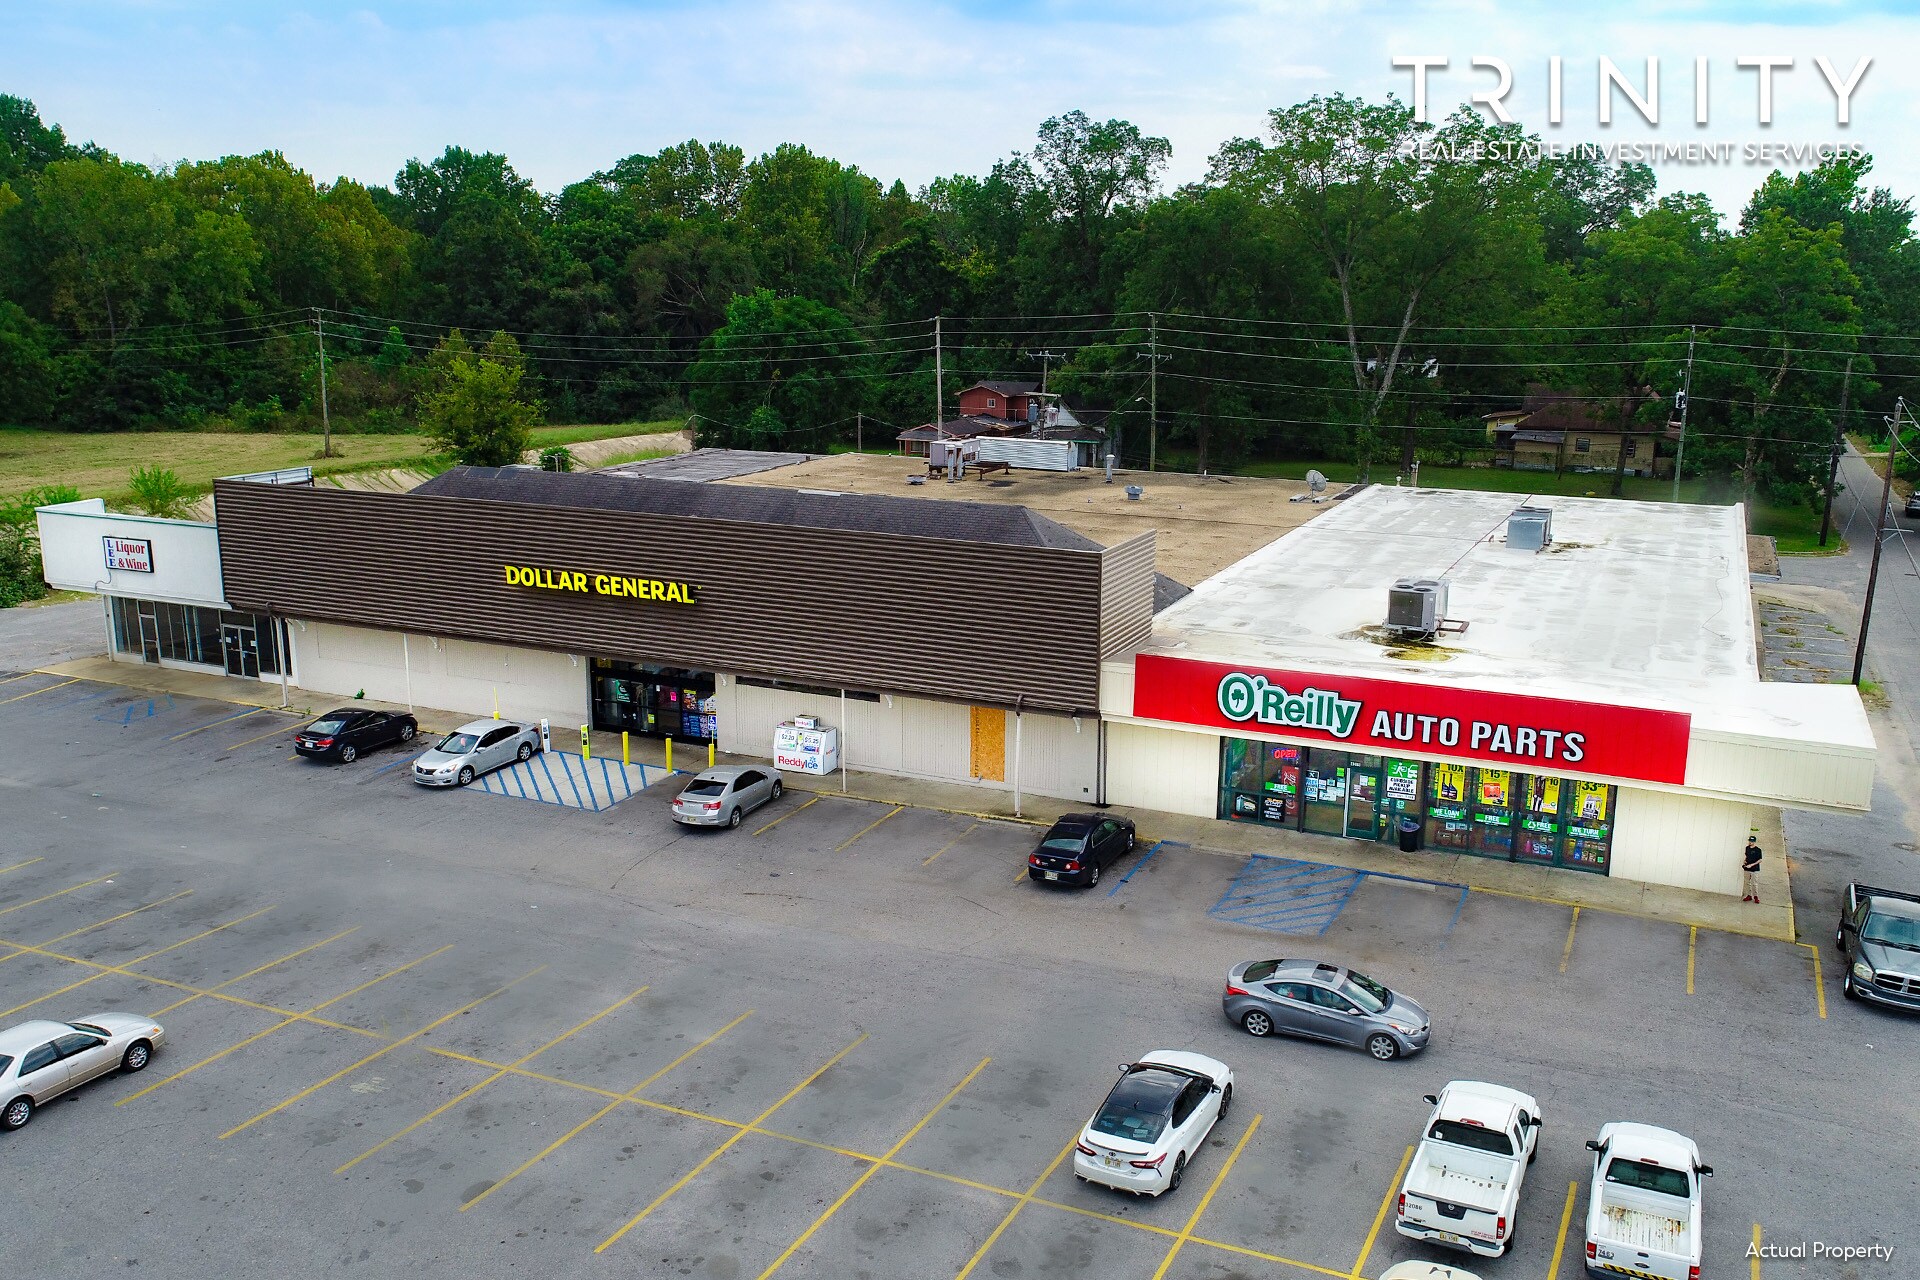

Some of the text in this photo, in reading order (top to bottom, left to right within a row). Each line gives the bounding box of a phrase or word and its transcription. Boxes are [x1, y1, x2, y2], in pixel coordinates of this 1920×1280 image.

[115, 541, 145, 555] Liquor
[505, 565, 695, 604] DOLLAR GENERAL
[1220, 675, 1585, 761] O'Reilly AUTO PARTS
[1273, 749, 1298, 759] OPEN
[1433, 807, 1443, 815] WE
[1444, 808, 1460, 817] LOAN
[1485, 814, 1500, 822] FREE
[1571, 826, 1583, 834] WE
